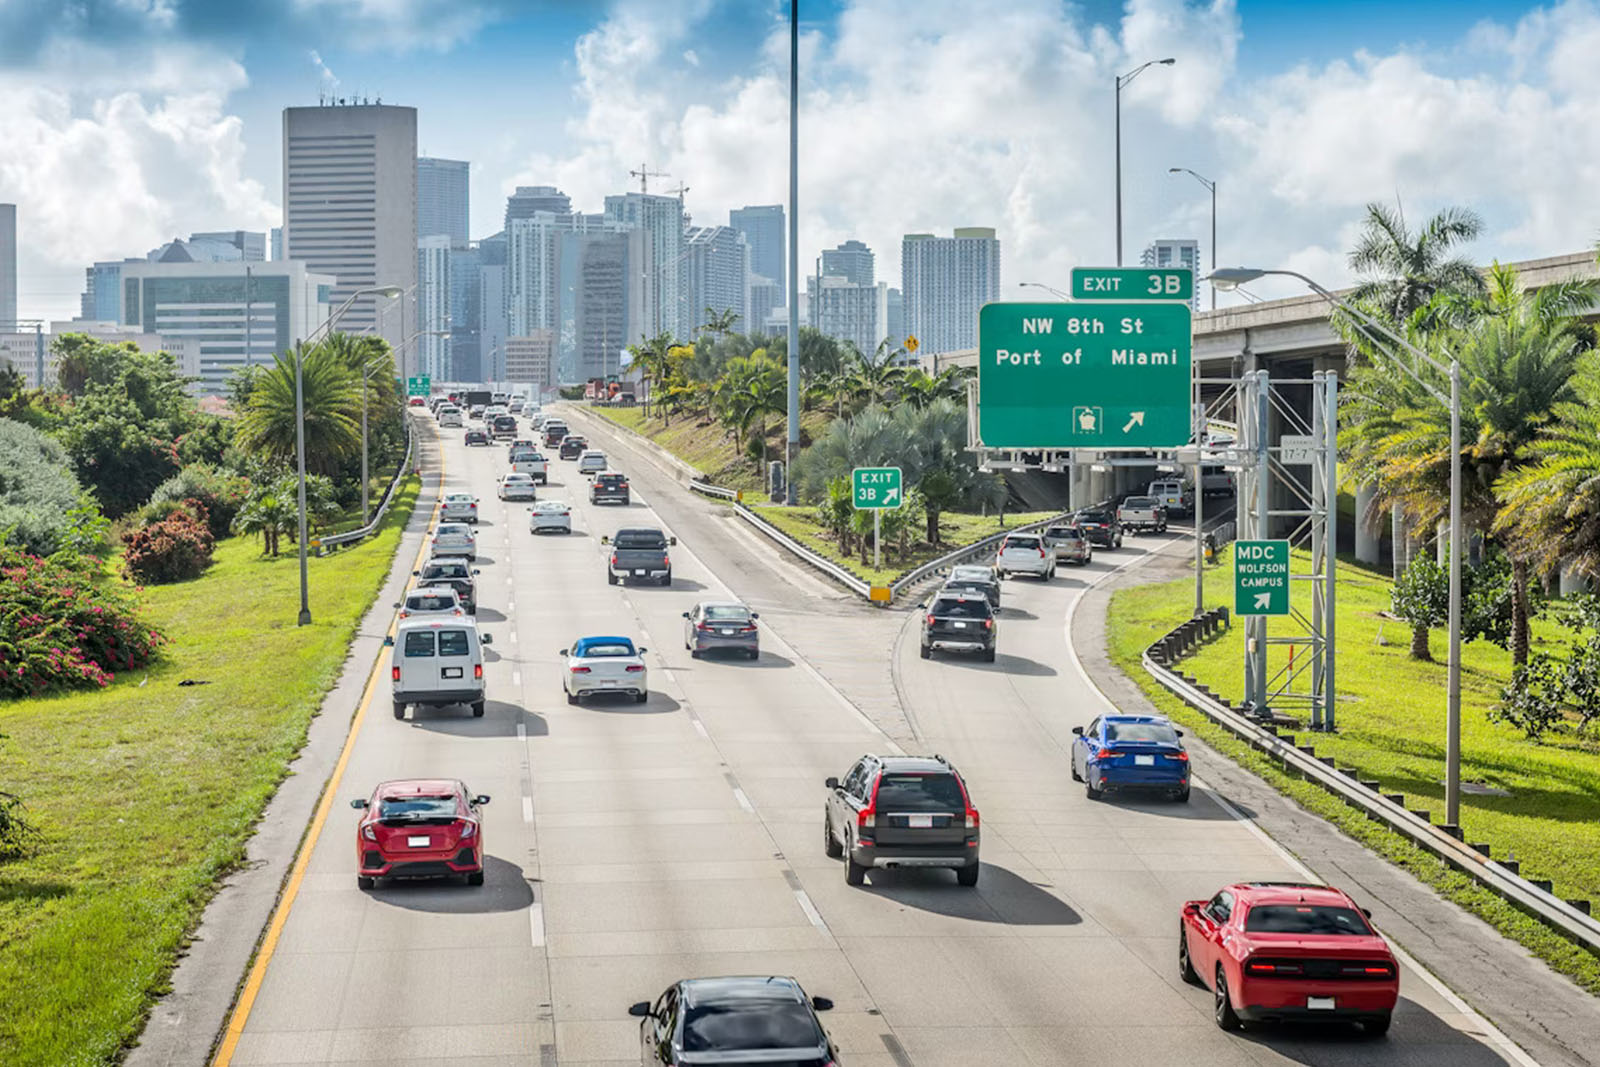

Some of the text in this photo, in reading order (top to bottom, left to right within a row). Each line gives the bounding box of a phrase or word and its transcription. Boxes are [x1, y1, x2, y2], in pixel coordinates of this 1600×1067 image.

[1083, 275, 1181, 294] EXIT 3B
[1022, 318, 1143, 334] NW 8th St
[996, 348, 1177, 365] Port of Miami
[861, 473, 893, 483] EXIT
[859, 488, 876, 500] 3B
[1238, 546, 1275, 559] MDC
[1238, 563, 1287, 573] WOLFSON
[1241, 577, 1283, 587] CAMPUS
